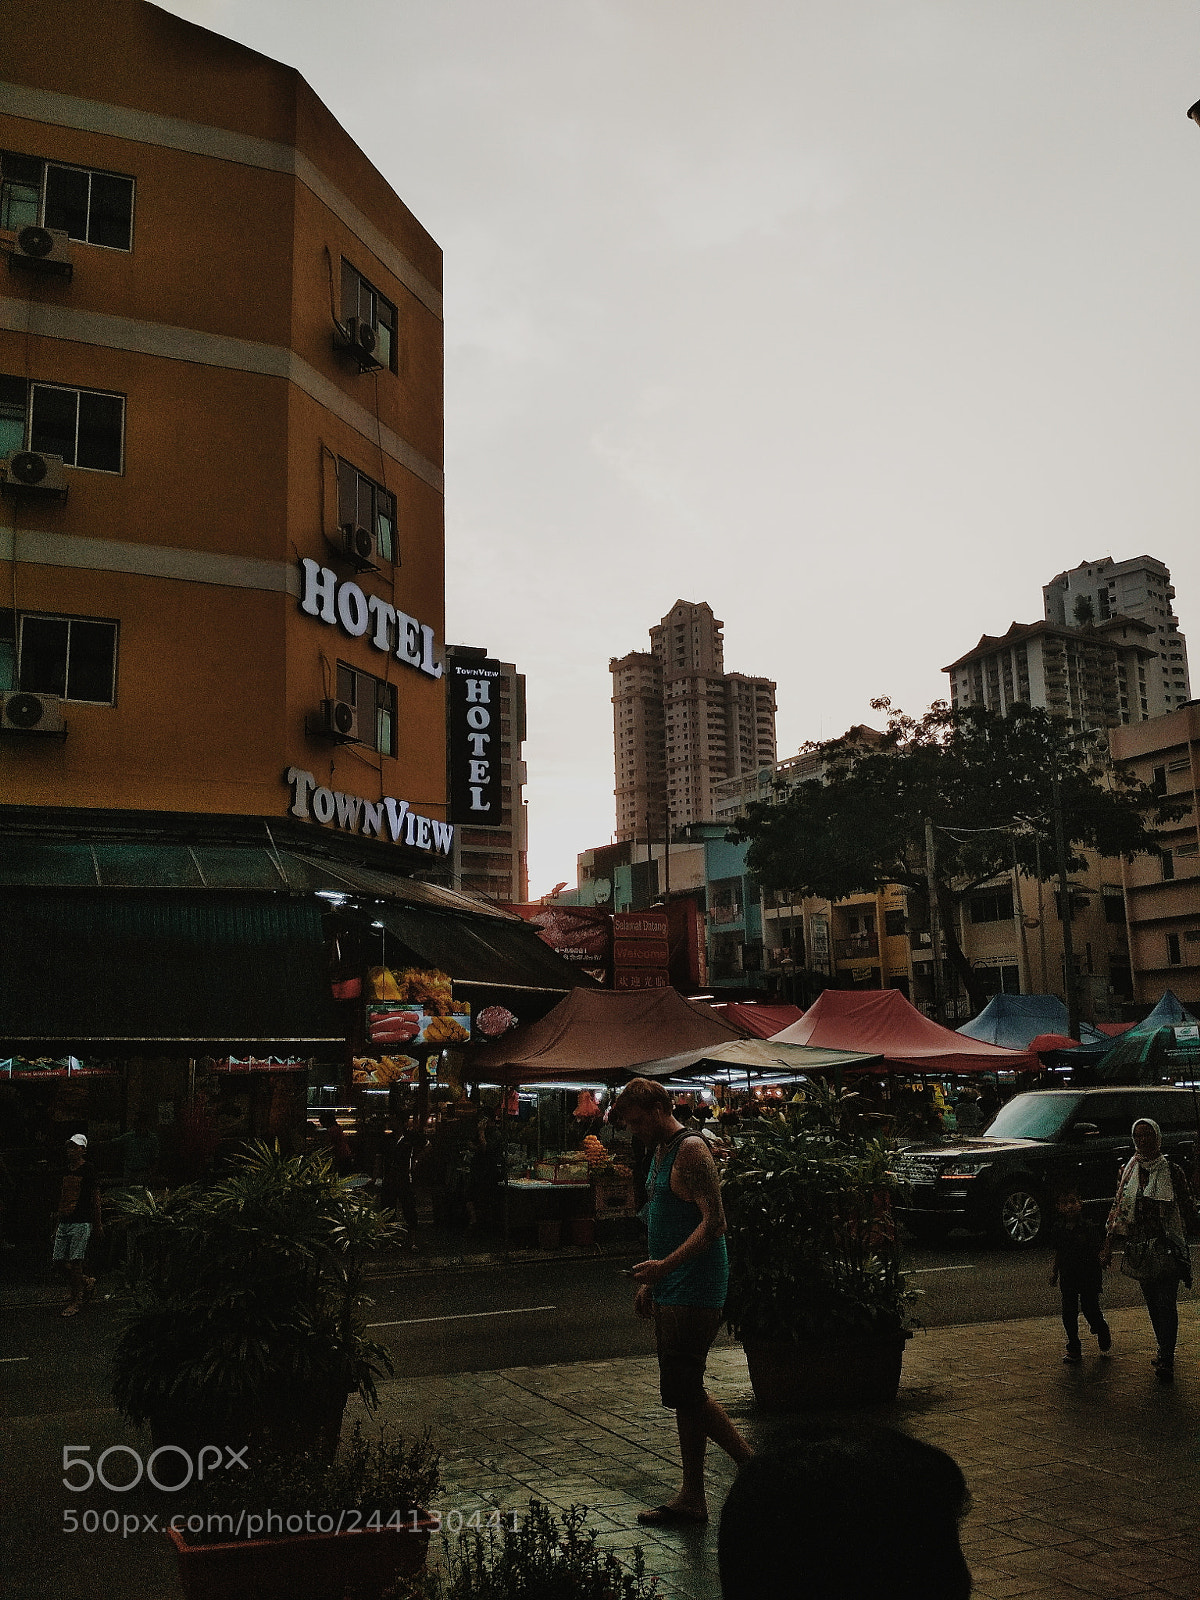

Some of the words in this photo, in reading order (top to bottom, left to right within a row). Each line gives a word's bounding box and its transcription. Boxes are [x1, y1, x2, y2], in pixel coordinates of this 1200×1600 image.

[301, 557, 443, 679] HOTEL
[465, 678, 491, 811] HOTEL
[616, 947, 667, 959] Welcome
